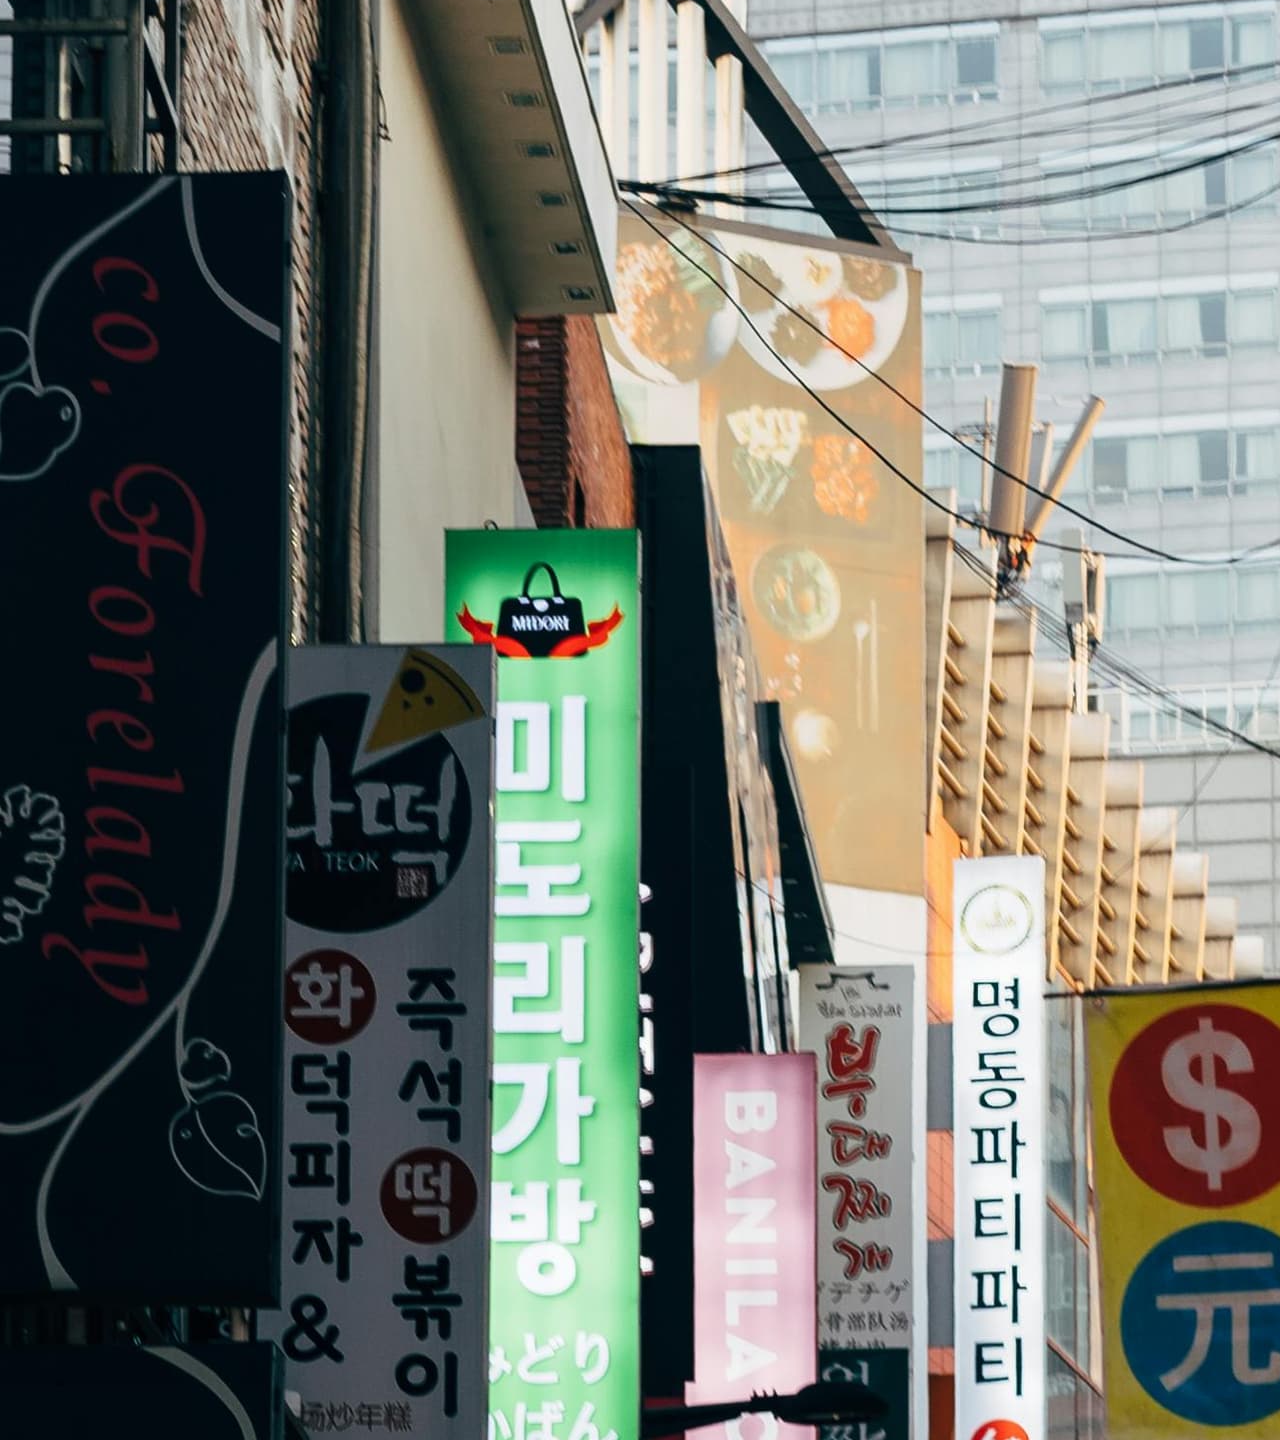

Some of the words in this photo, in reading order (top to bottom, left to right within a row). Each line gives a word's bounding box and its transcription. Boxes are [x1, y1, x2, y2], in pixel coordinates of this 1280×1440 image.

[41, 464, 205, 1006] Forelady
[511, 613, 571, 633] MIDORI
[326, 850, 380, 873] TEOK
[492, 694, 596, 1297] 미도리가방
[288, 962, 363, 1282] 화덕피자
[392, 967, 467, 1418] 즉석떡볶이
[724, 1089, 778, 1392] BANILA
[970, 978, 1026, 1397] 명동파티파티
